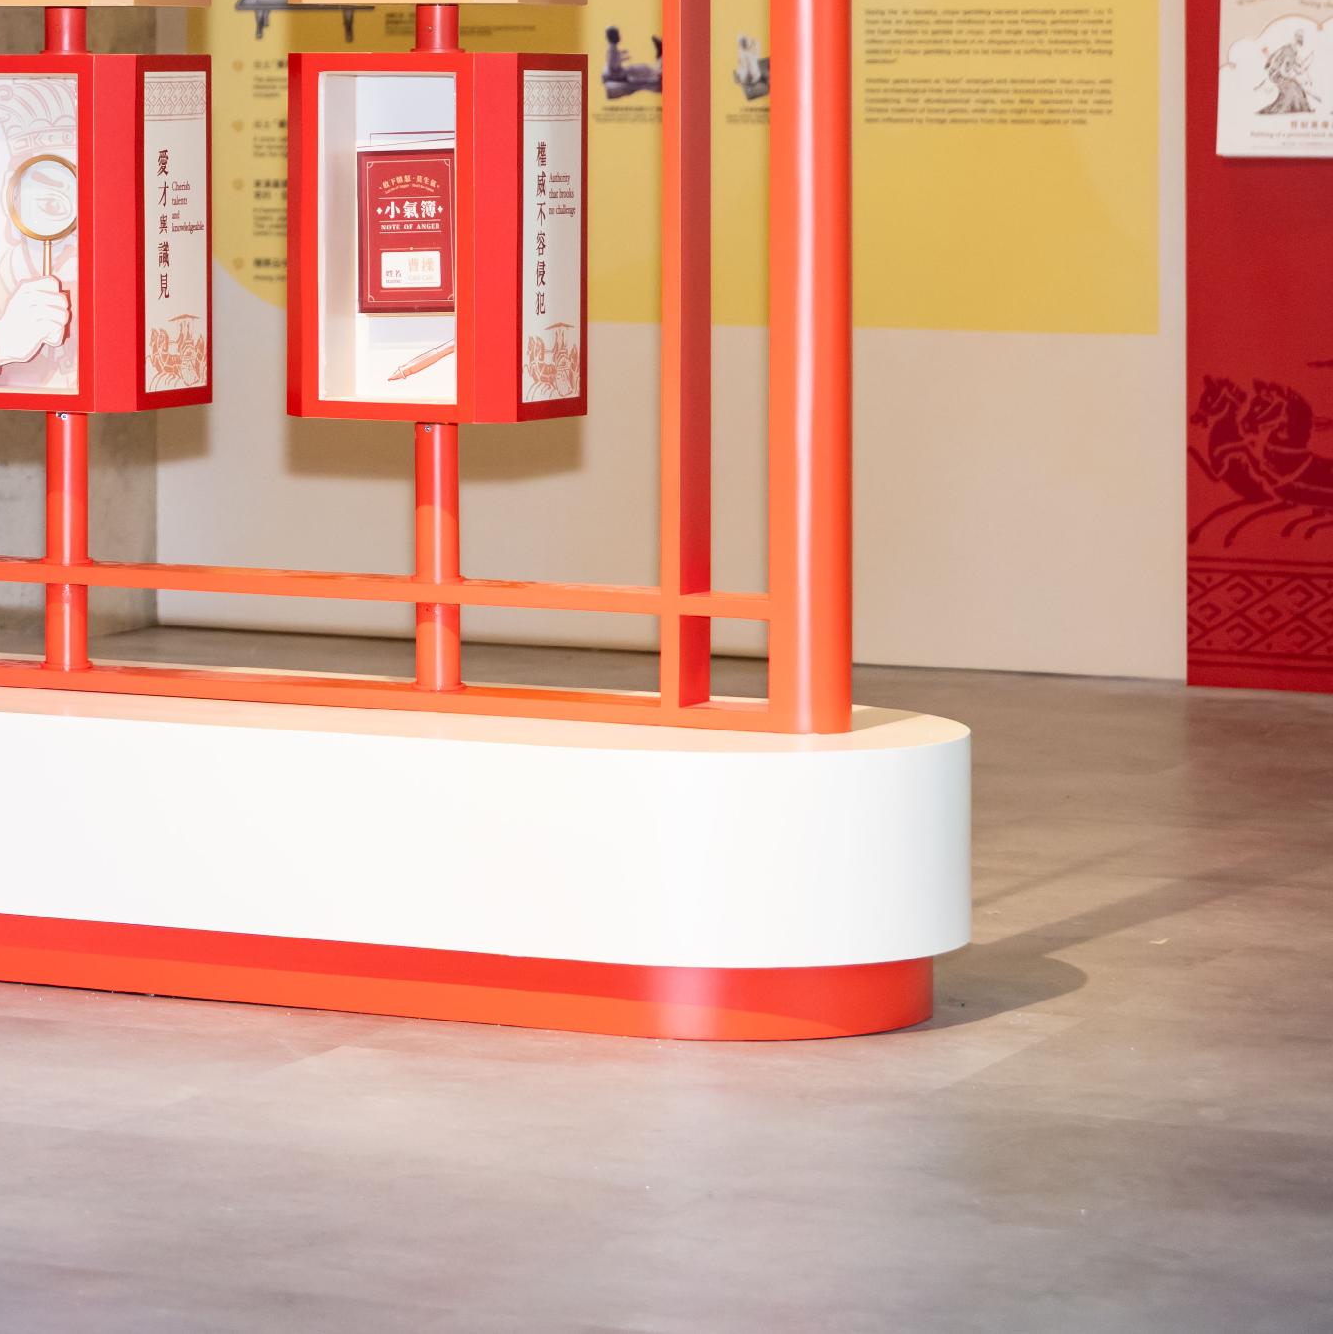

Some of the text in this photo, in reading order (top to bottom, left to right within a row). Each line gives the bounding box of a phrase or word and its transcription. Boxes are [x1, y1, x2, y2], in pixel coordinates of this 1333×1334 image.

[549, 172, 571, 184] Authority
[171, 180, 191, 192] Cherish
[549, 188, 575, 199] that brooks
[171, 210, 180, 219] and
[384, 200, 437, 219] 小氣簿
[549, 204, 576, 217] no challenge
[157, 149, 170, 300] 愛才與識見
[171, 222, 205, 235] knowledgeable
[536, 141, 547, 316] 權威不容侵犯
